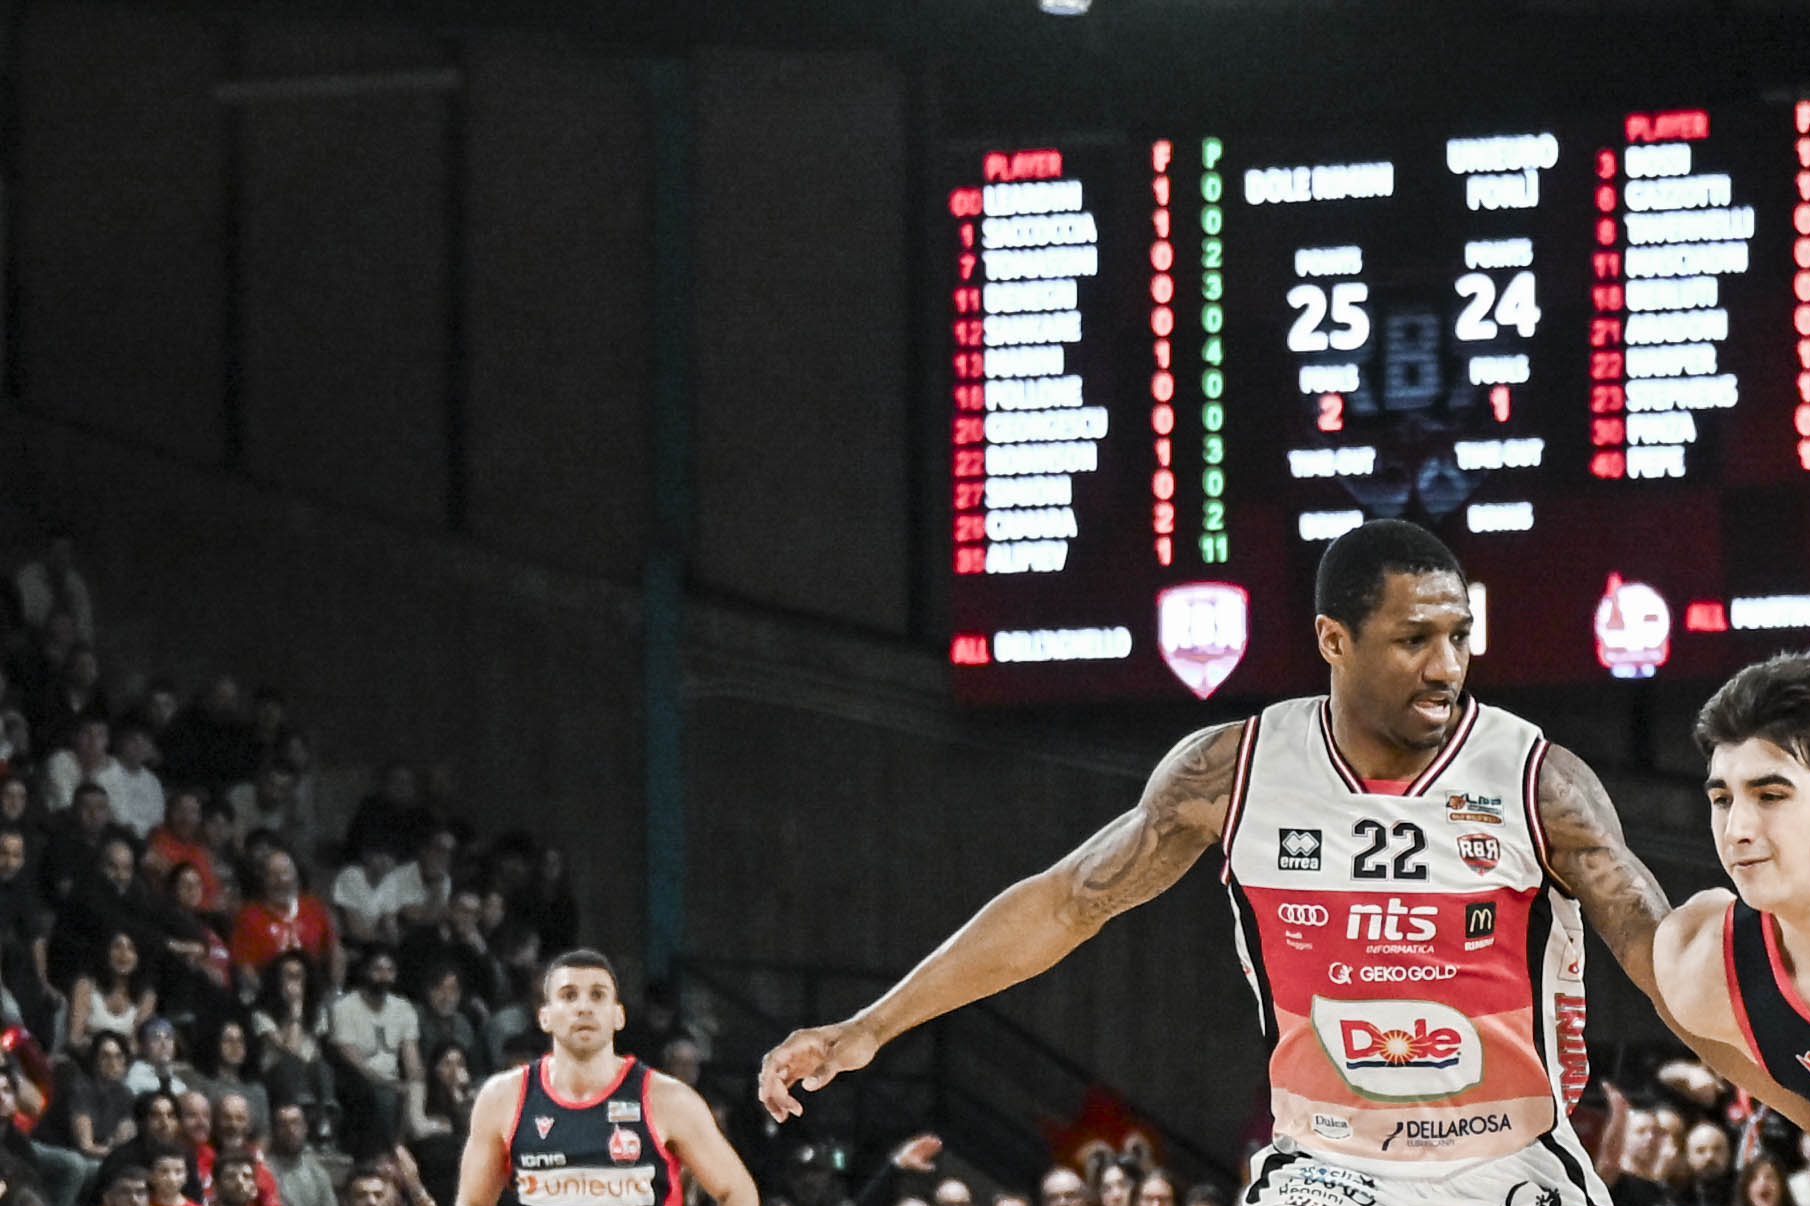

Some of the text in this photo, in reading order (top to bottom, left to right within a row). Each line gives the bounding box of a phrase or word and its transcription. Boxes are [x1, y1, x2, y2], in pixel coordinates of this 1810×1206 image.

[1154, 172, 1222, 206] 1 0
[1154, 205, 1222, 238] 1 0
[1151, 238, 1222, 273] 0 2
[1151, 271, 1222, 305] 0 3
[1152, 304, 1223, 337] 0 0
[1287, 283, 1370, 351] 25
[1455, 271, 1541, 340] 24
[1155, 337, 1223, 370] 1 4
[1152, 369, 1223, 402] 0 0
[1153, 402, 1223, 435] 0 0
[1318, 394, 1343, 431] 2
[1490, 385, 1510, 422] 1
[1156, 435, 1224, 468] 1 3
[1153, 467, 1224, 501] 0 0
[1154, 500, 1224, 534] 2 2
[1156, 533, 1228, 567] 1 11
[1352, 818, 1428, 881] 22
[1346, 898, 1438, 941] nts
[1365, 944, 1435, 955] INFORMATICA
[1340, 1018, 1463, 1060] Dole
[1555, 992, 1590, 1117] IMINI
[1406, 1113, 1512, 1140] DELLAROSA
